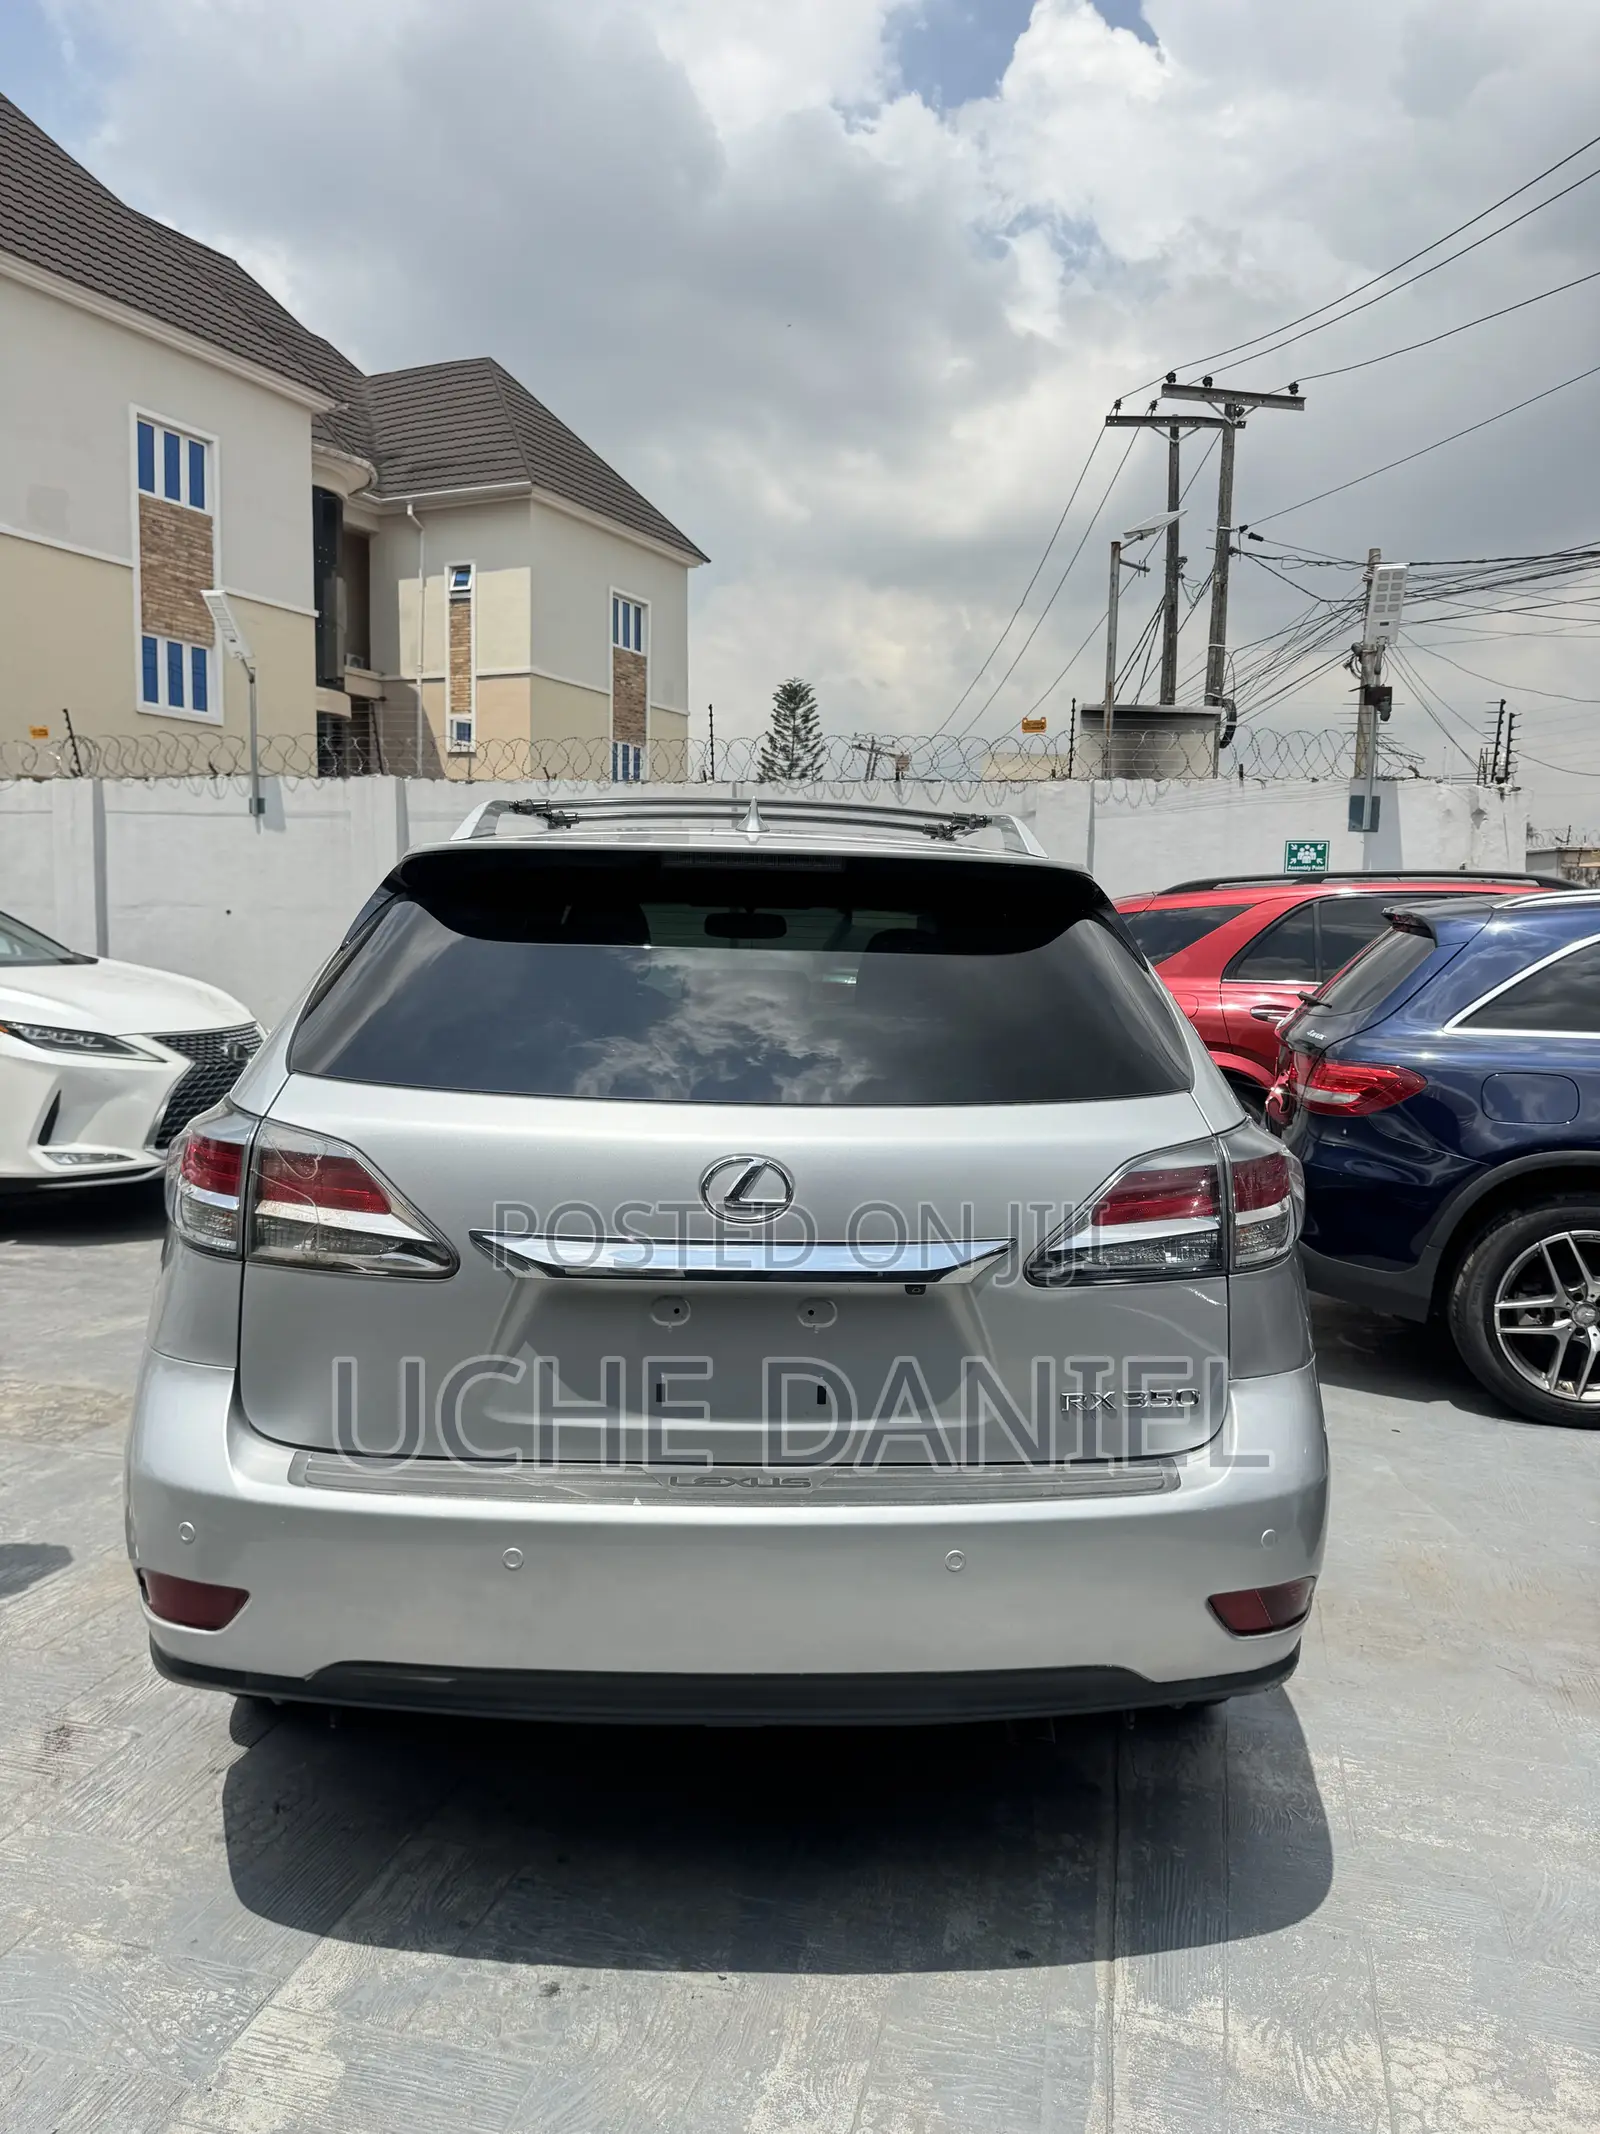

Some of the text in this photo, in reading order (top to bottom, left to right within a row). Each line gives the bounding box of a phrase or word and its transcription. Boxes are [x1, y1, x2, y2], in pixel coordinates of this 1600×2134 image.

[1061, 1388, 1201, 1412] RX 350
[669, 1476, 812, 1489] LEXUS
